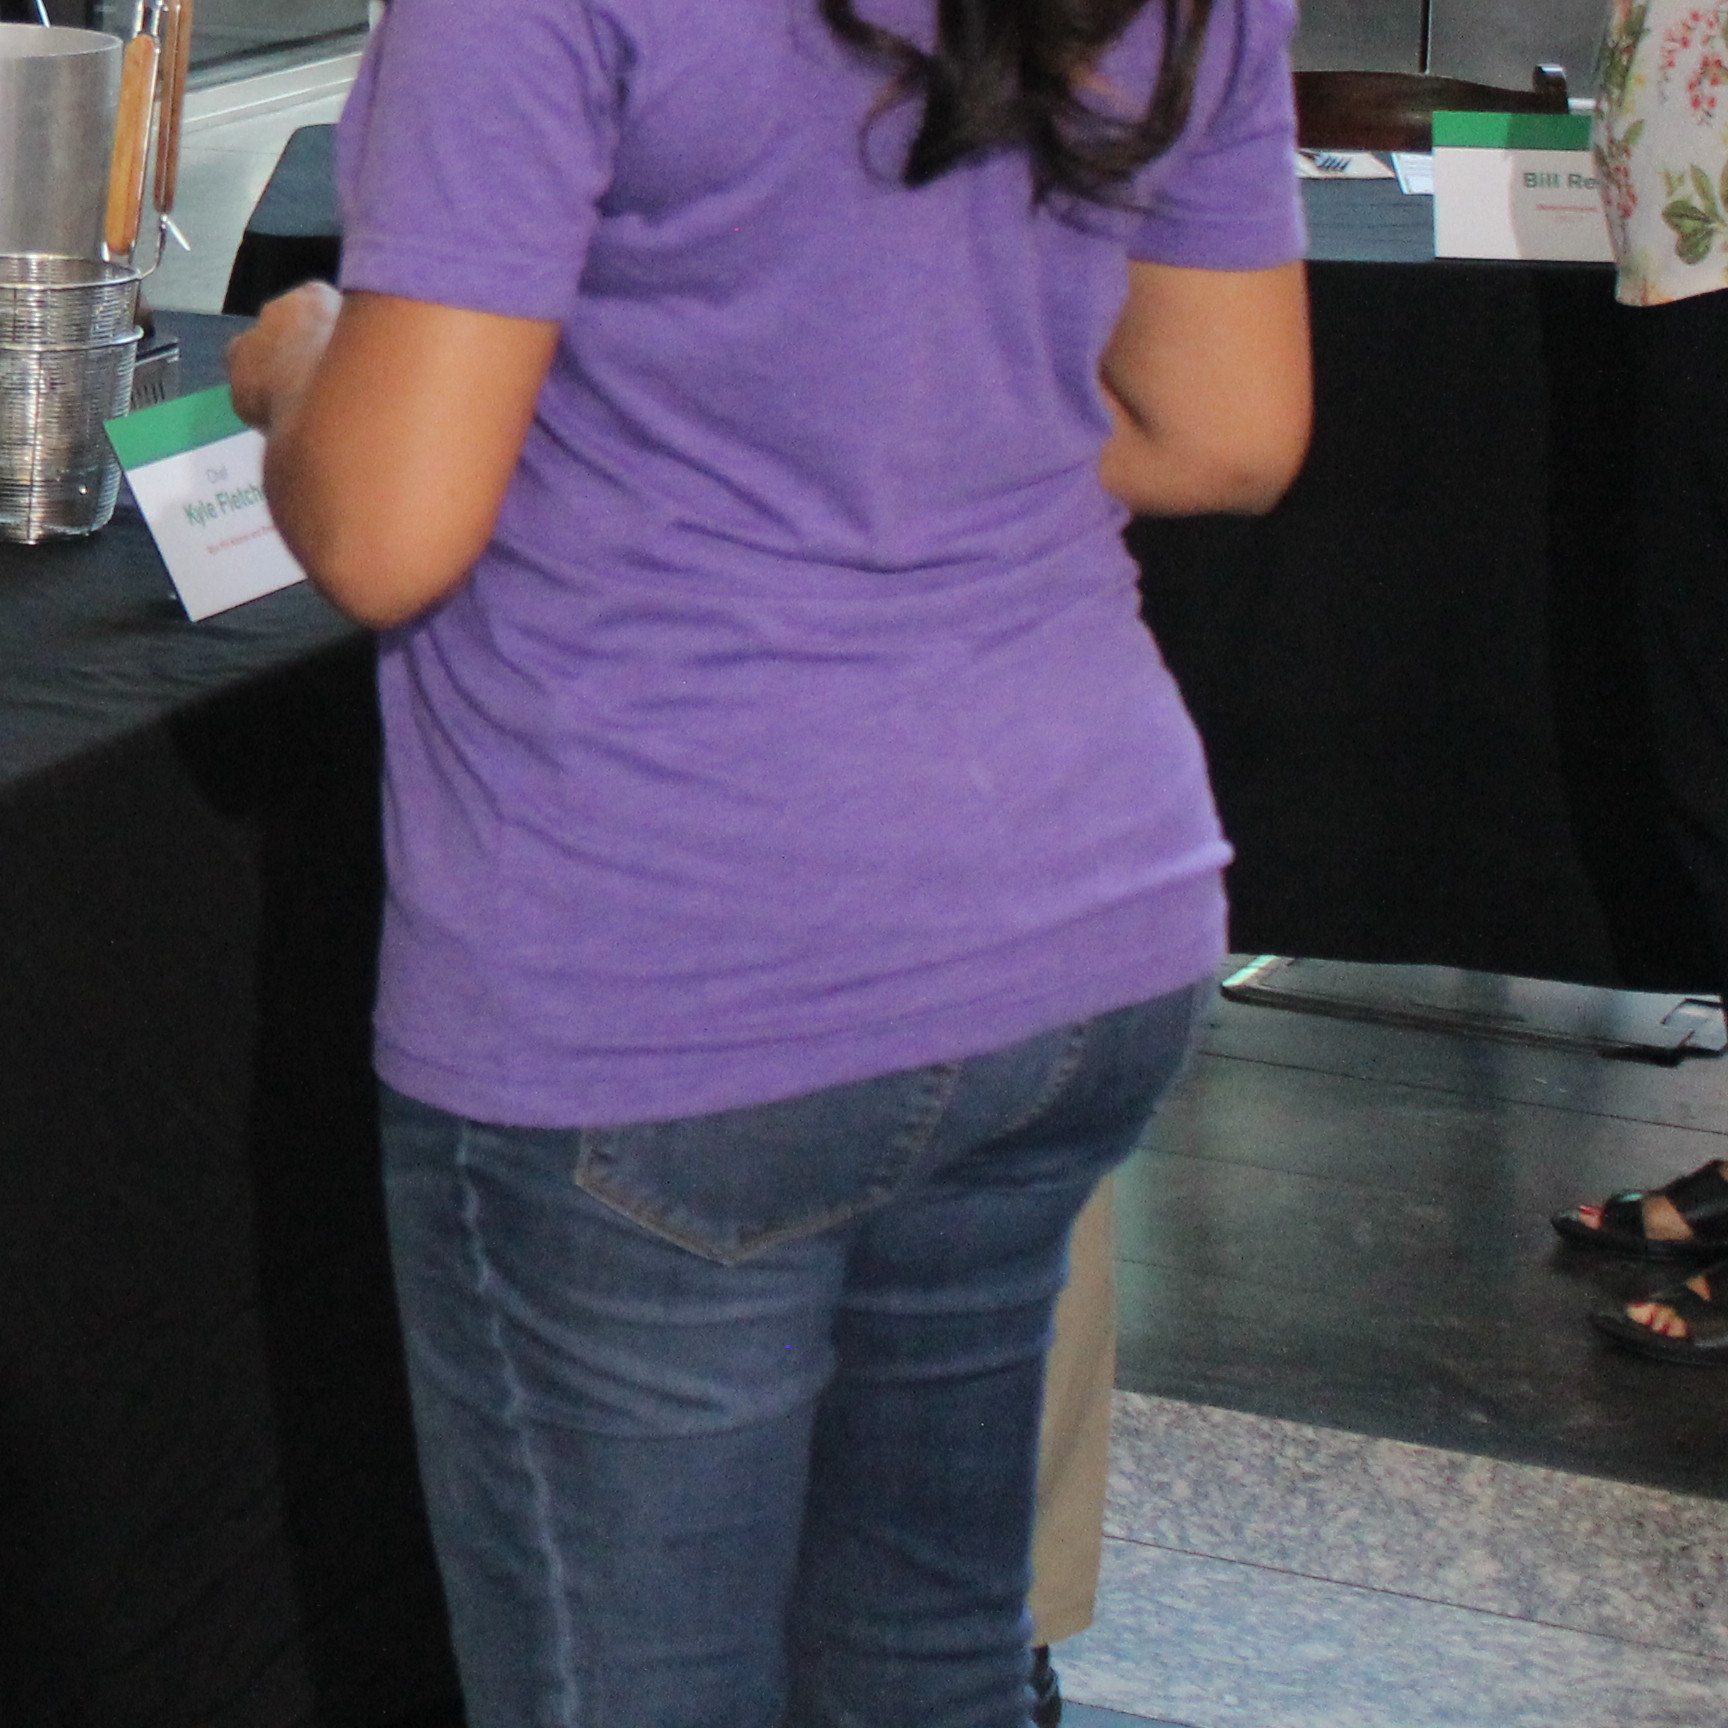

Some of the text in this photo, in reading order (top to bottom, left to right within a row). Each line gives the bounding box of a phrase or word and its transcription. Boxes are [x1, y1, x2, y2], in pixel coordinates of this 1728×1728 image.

[1523, 172, 1560, 189] Bill
[182, 481, 265, 527] Kyle Fletch
